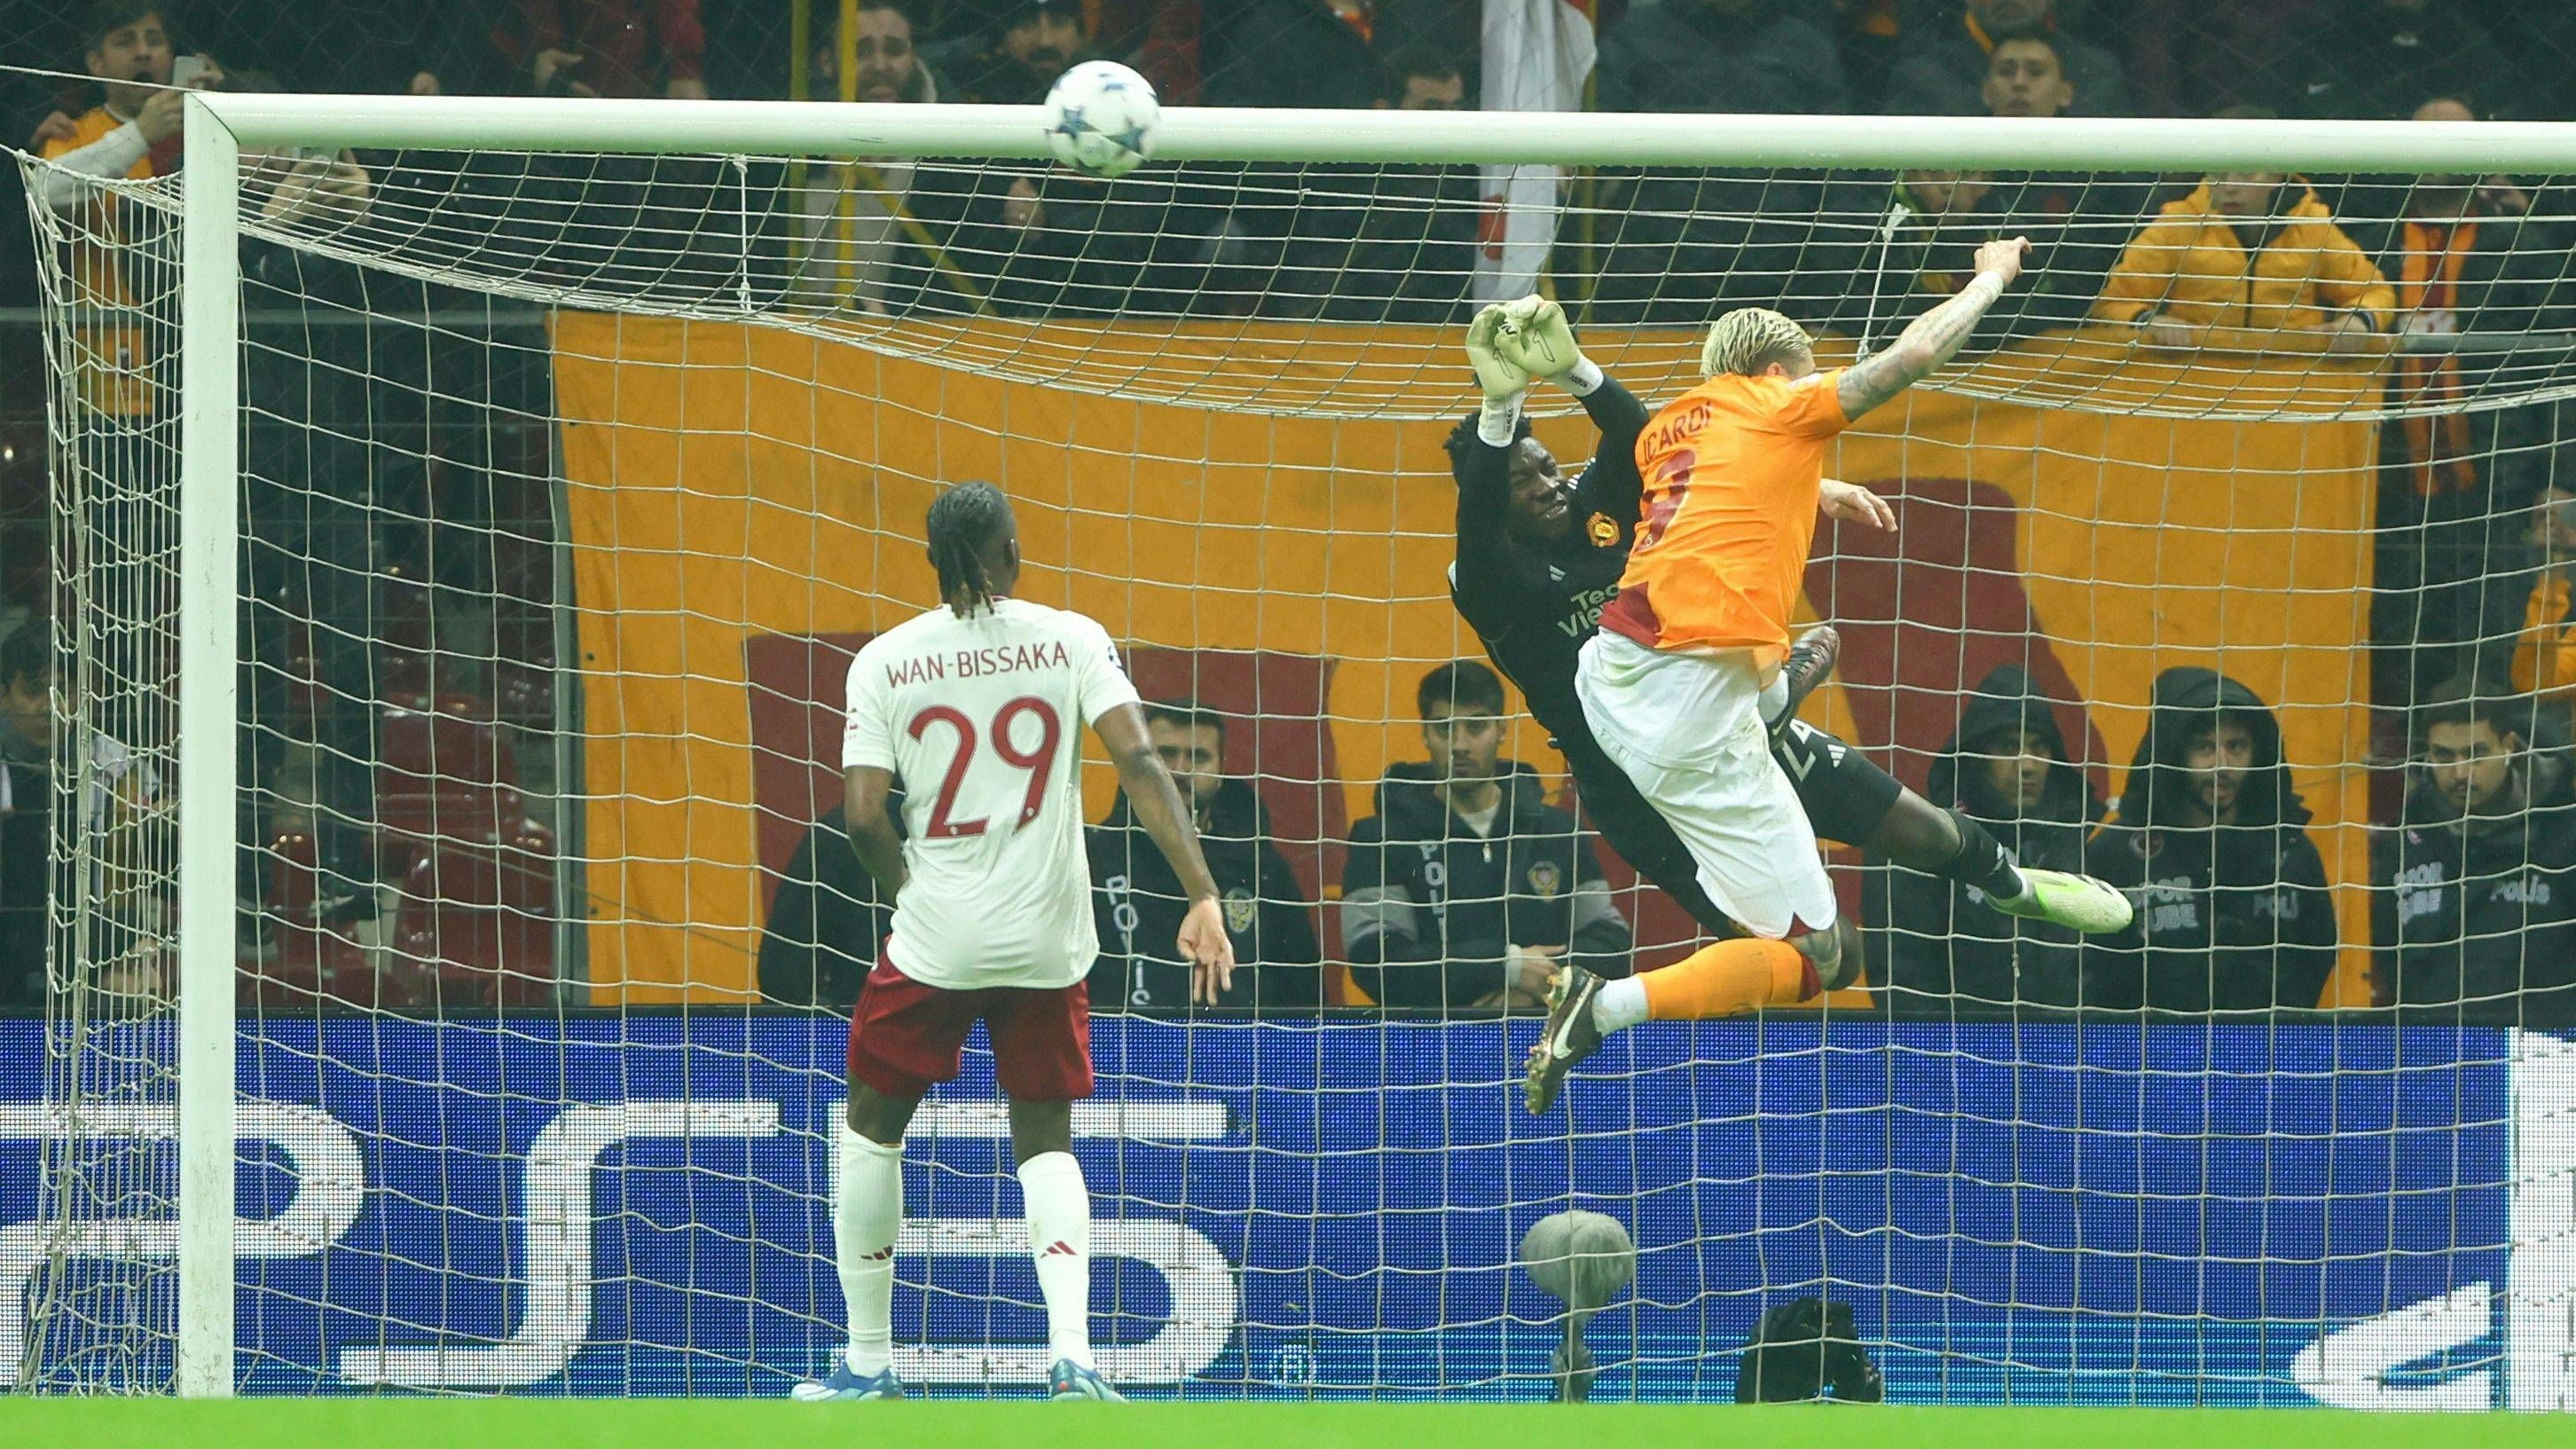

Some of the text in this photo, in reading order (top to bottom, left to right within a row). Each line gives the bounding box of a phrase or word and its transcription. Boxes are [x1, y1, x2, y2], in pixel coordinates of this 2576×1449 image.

[885, 641, 1071, 689] WAN-BISSAKA
[1557, 603, 1607, 638] Vie
[907, 696, 1062, 840] 29
[0, 1099, 1237, 1389] PS5
